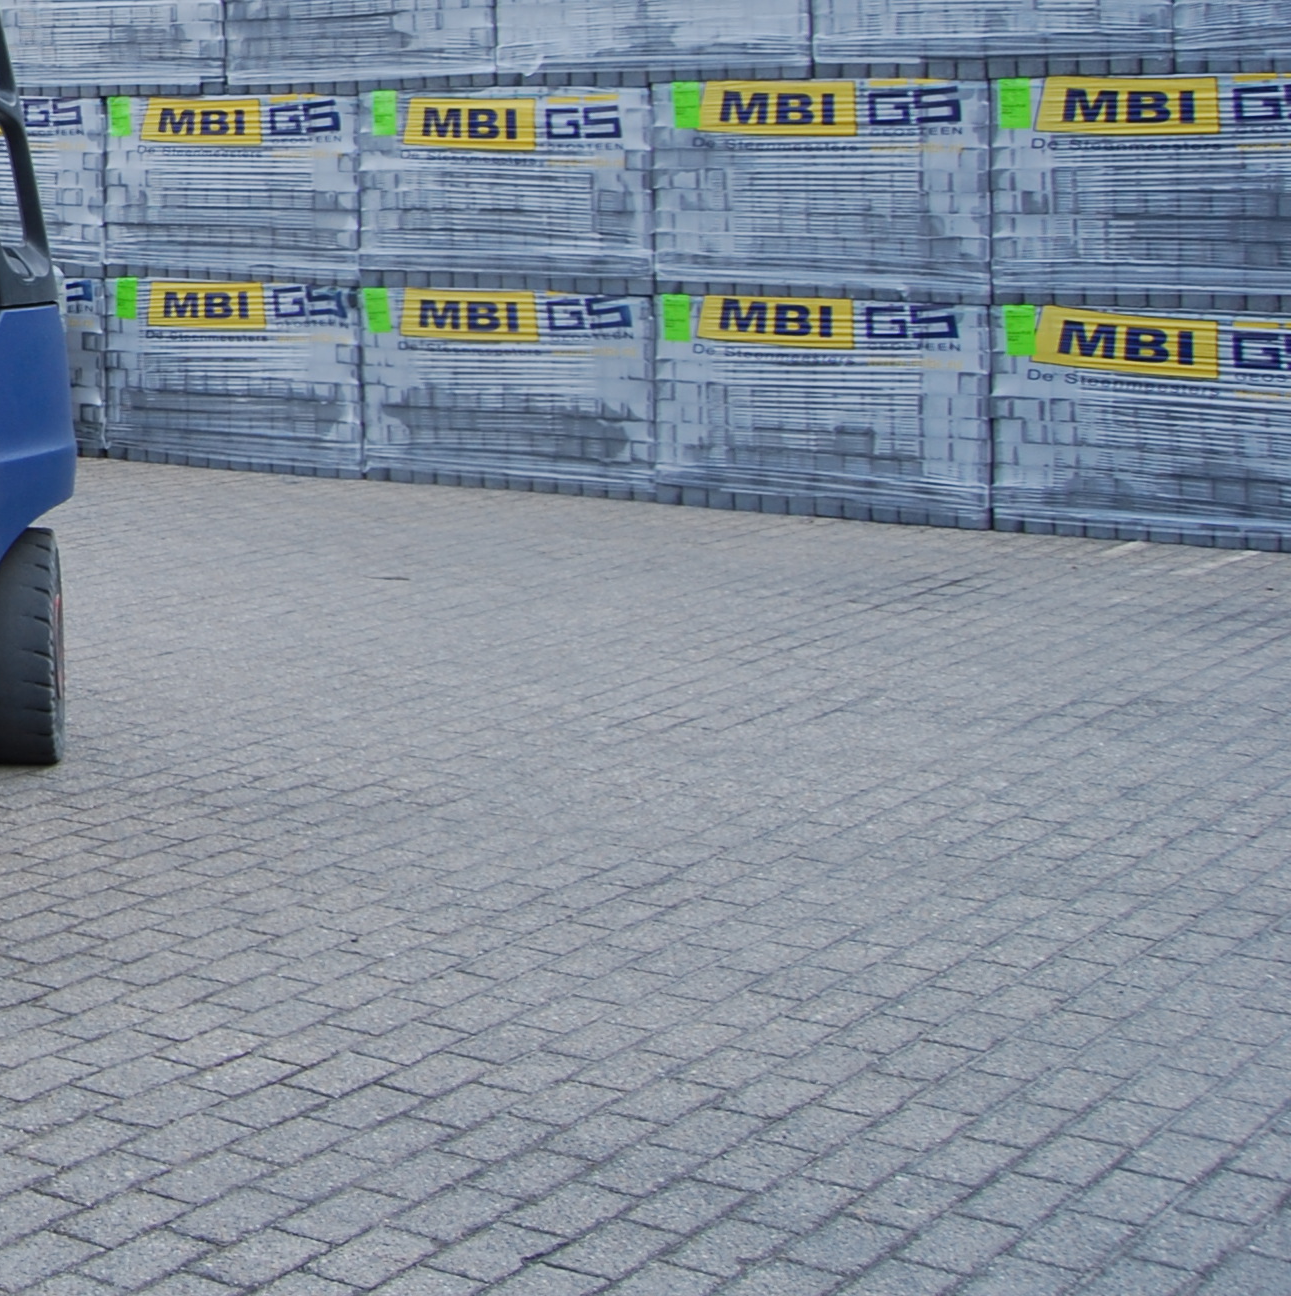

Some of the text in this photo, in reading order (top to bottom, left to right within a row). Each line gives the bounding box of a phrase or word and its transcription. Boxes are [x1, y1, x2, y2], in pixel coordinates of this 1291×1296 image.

[158, 99, 341, 135] MBI GS
[719, 90, 836, 125] MBI
[869, 86, 962, 125] GS
[1062, 87, 1196, 124] MBI
[1233, 84, 1291, 121] G
[422, 105, 622, 140] MBI GS
[1031, 138, 1057, 150] De
[163, 284, 347, 319] MBI GS
[419, 296, 632, 332] MBI GS
[719, 298, 833, 338] MBI
[866, 305, 959, 339] GS
[1057, 320, 1194, 365] MBI
[1233, 332, 1291, 370] G
[1027, 369, 1054, 382] De
